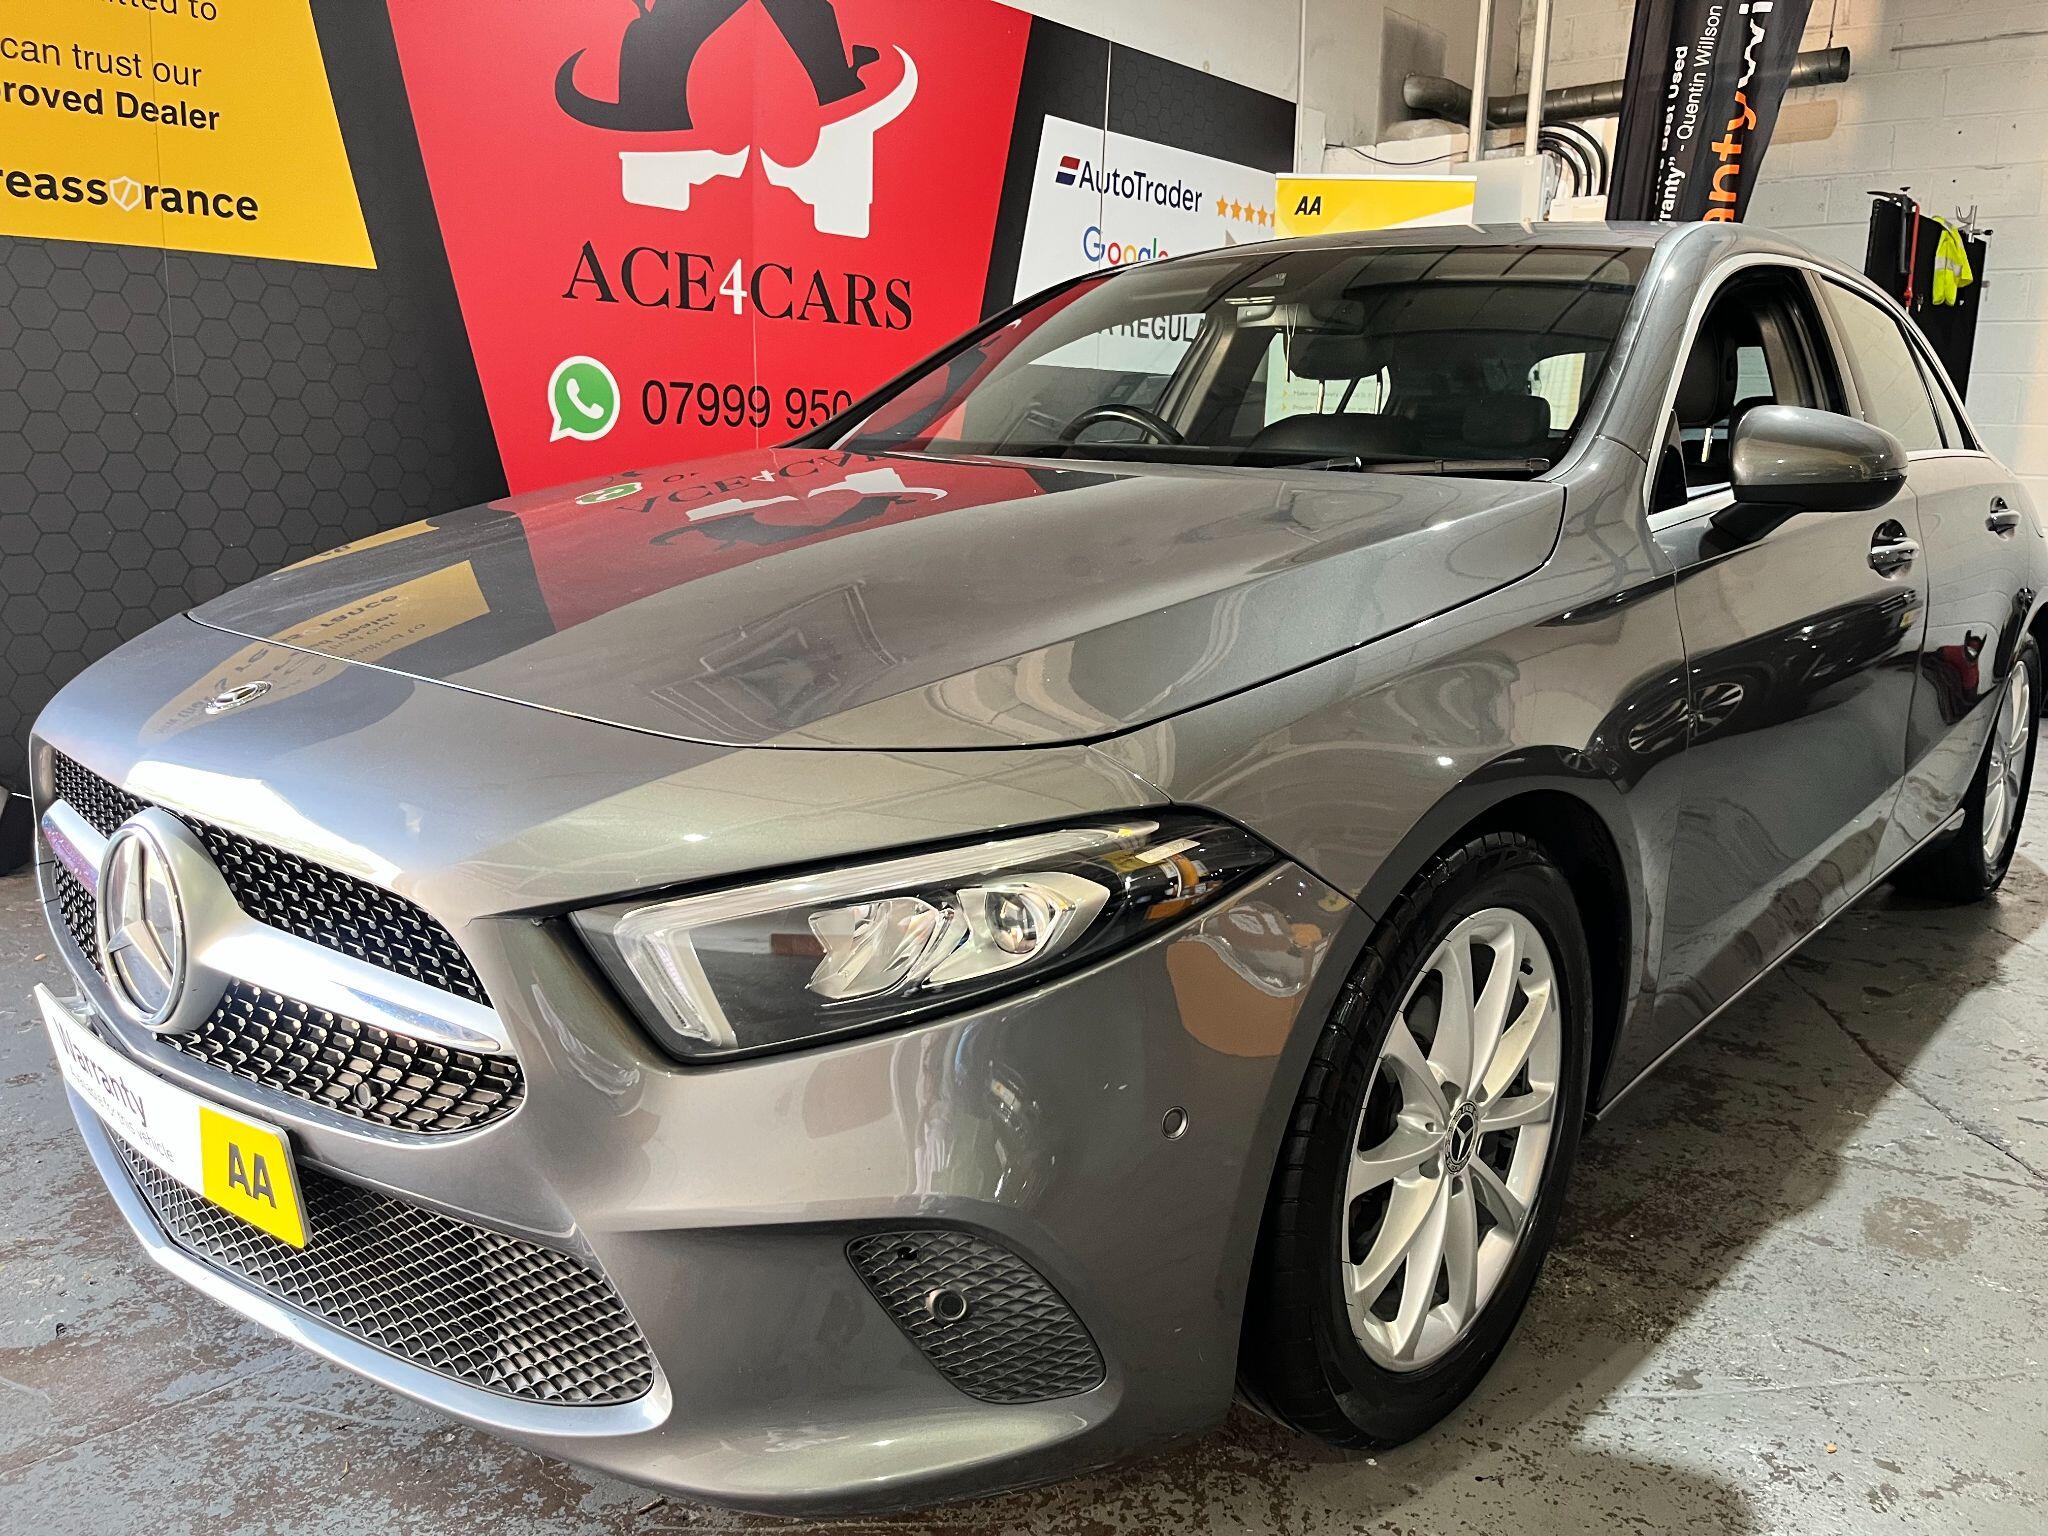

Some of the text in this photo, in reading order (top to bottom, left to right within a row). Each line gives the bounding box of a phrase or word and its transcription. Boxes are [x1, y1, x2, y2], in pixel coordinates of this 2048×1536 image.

[0, 37, 202, 87] can trust our
[1668, 46, 1688, 99] Used
[0, 81, 220, 130] roved Dealer
[1659, 156, 1686, 222] ranty”
[1676, 72, 1707, 140] Quentin
[1693, 5, 1723, 67] Willson
[1079, 160, 1203, 213] AutoTrader
[1294, 195, 1321, 216] AA
[561, 240, 913, 331] ACE4CARS
[642, 380, 771, 429] 07999
[53, 1016, 147, 1127] Warranty
[228, 1142, 277, 1209] AA
